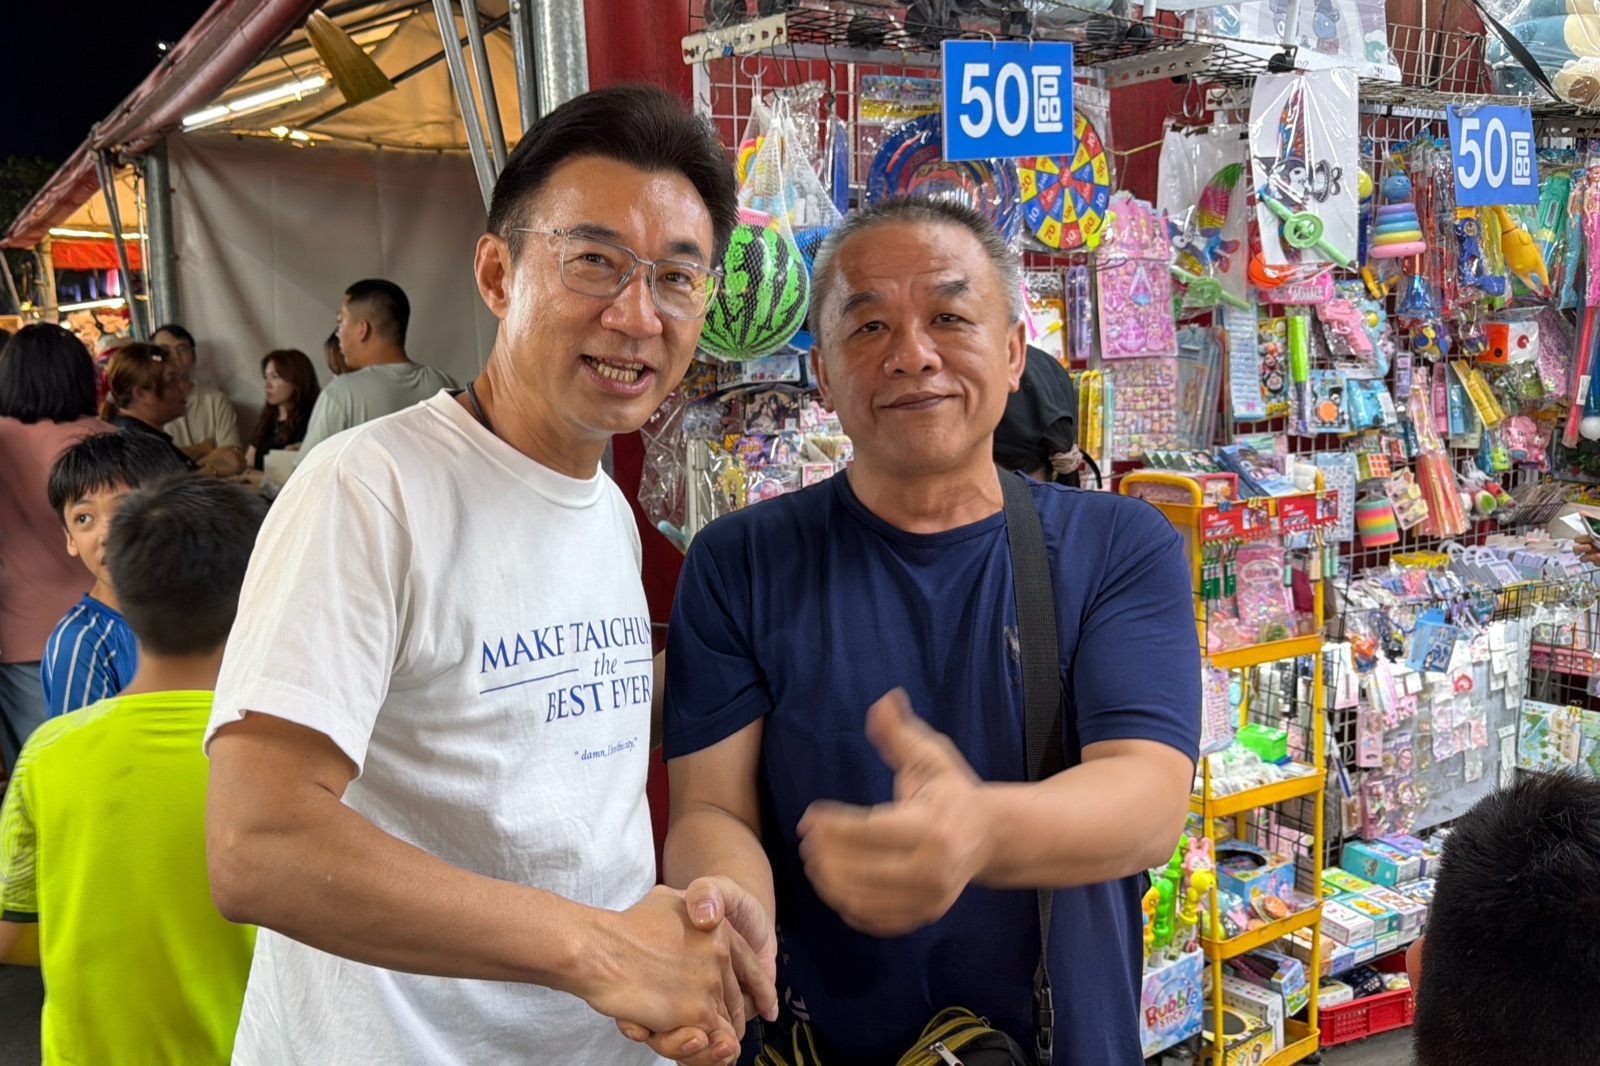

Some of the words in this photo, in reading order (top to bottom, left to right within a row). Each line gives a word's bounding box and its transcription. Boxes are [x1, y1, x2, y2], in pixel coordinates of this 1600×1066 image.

[959, 62, 1064, 139] 50區
[1087, 132, 1097, 148] 10
[1457, 117, 1531, 189] 50區
[1020, 175, 1032, 193] 20
[1095, 192, 1106, 208] 10
[1028, 207, 1040, 223] 10
[1043, 224, 1056, 240] 70
[1065, 229, 1076, 245] 10
[479, 624, 565, 674] MAKE
[593, 652, 618, 677] the
[545, 681, 604, 723] BEST
[611, 674, 651, 709] EVER
[1144, 986, 1199, 1029] Bubble
[1159, 1009, 1184, 1028] STICK
